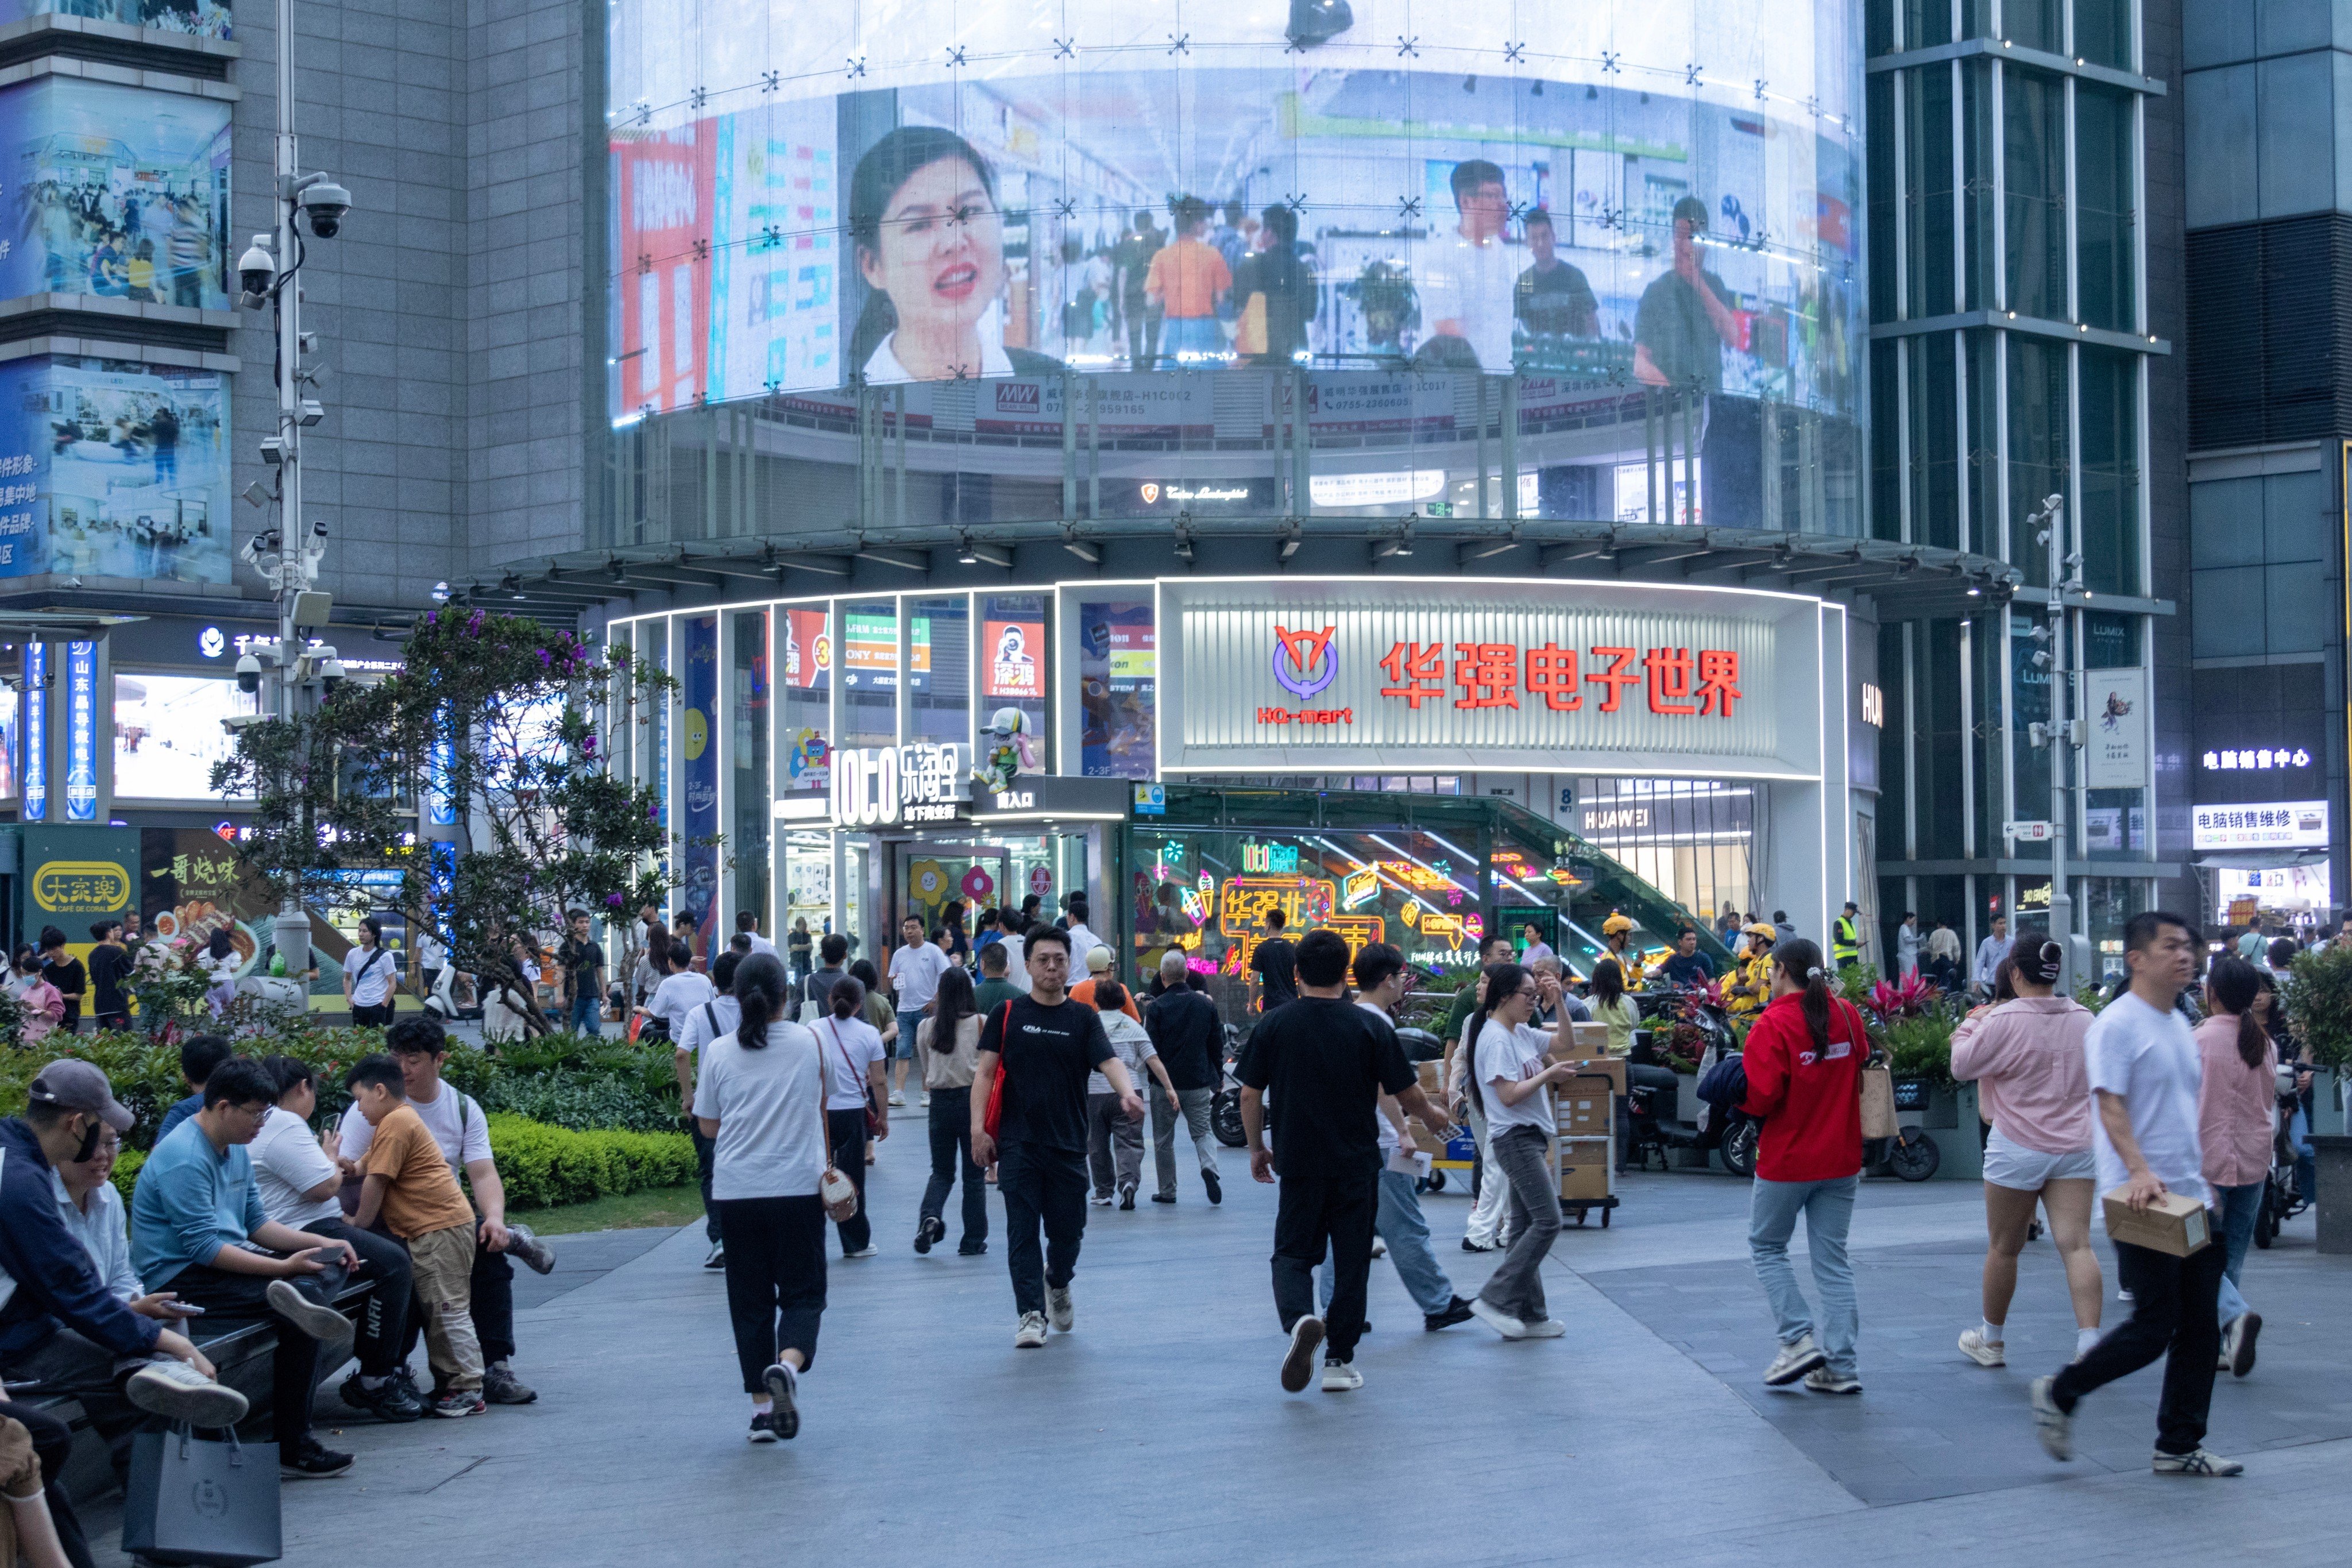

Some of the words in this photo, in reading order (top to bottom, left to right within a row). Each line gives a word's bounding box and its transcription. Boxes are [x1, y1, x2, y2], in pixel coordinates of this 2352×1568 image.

[1046, 403, 1145, 415] 07-2959165
[1336, 397, 1413, 410] 0755-2360605
[0, 544, 14, 565] 区
[787, 651, 800, 674] 鸿
[815, 640, 829, 665] 上3
[845, 650, 871, 661] ONY
[994, 663, 1035, 685] 深鸿
[1379, 642, 1742, 717] 华强电子世界
[2023, 669, 2051, 684] LUMI
[75, 660, 89, 778] 山东晶导微电子
[1257, 707, 1353, 724] HQ-mart
[2203, 748, 2310, 770] 电脑销售中心
[1088, 766, 1110, 775] 2-3F
[1561, 788, 1572, 804] 8
[904, 805, 956, 821] 地下商业街
[1585, 808, 1648, 830] HUAWEI
[2198, 809, 2291, 829] 电脑销售维修
[150, 853, 240, 885] 一哥烧味
[1226, 890, 1306, 928] 华强北
[1430, 918, 1454, 930] OPEN
